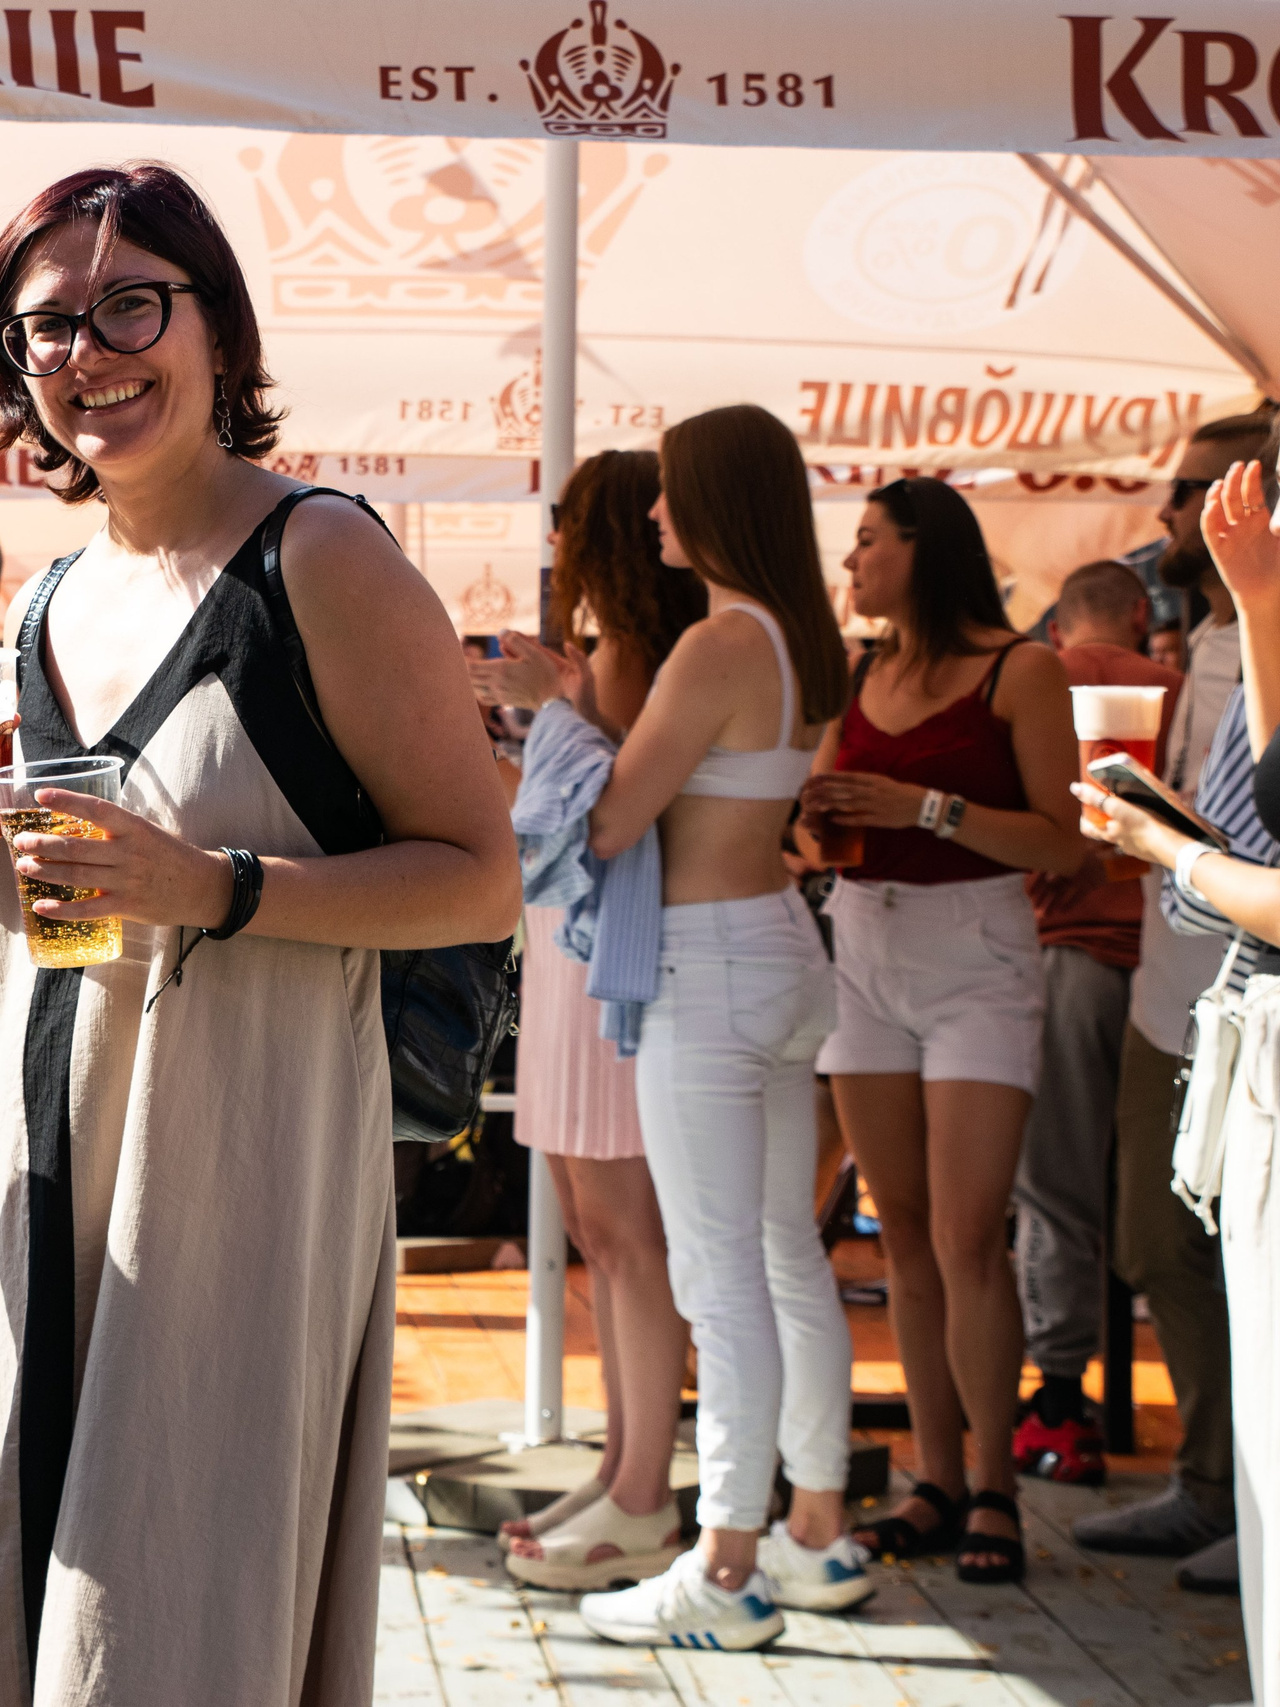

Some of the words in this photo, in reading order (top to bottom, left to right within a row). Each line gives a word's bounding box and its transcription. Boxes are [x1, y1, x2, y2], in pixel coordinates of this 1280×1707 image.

[379, 66, 499, 103] EST.
[706, 72, 836, 109] 1581
[1057, 14, 1280, 143] KR
[338, 456, 407, 477] 1581
